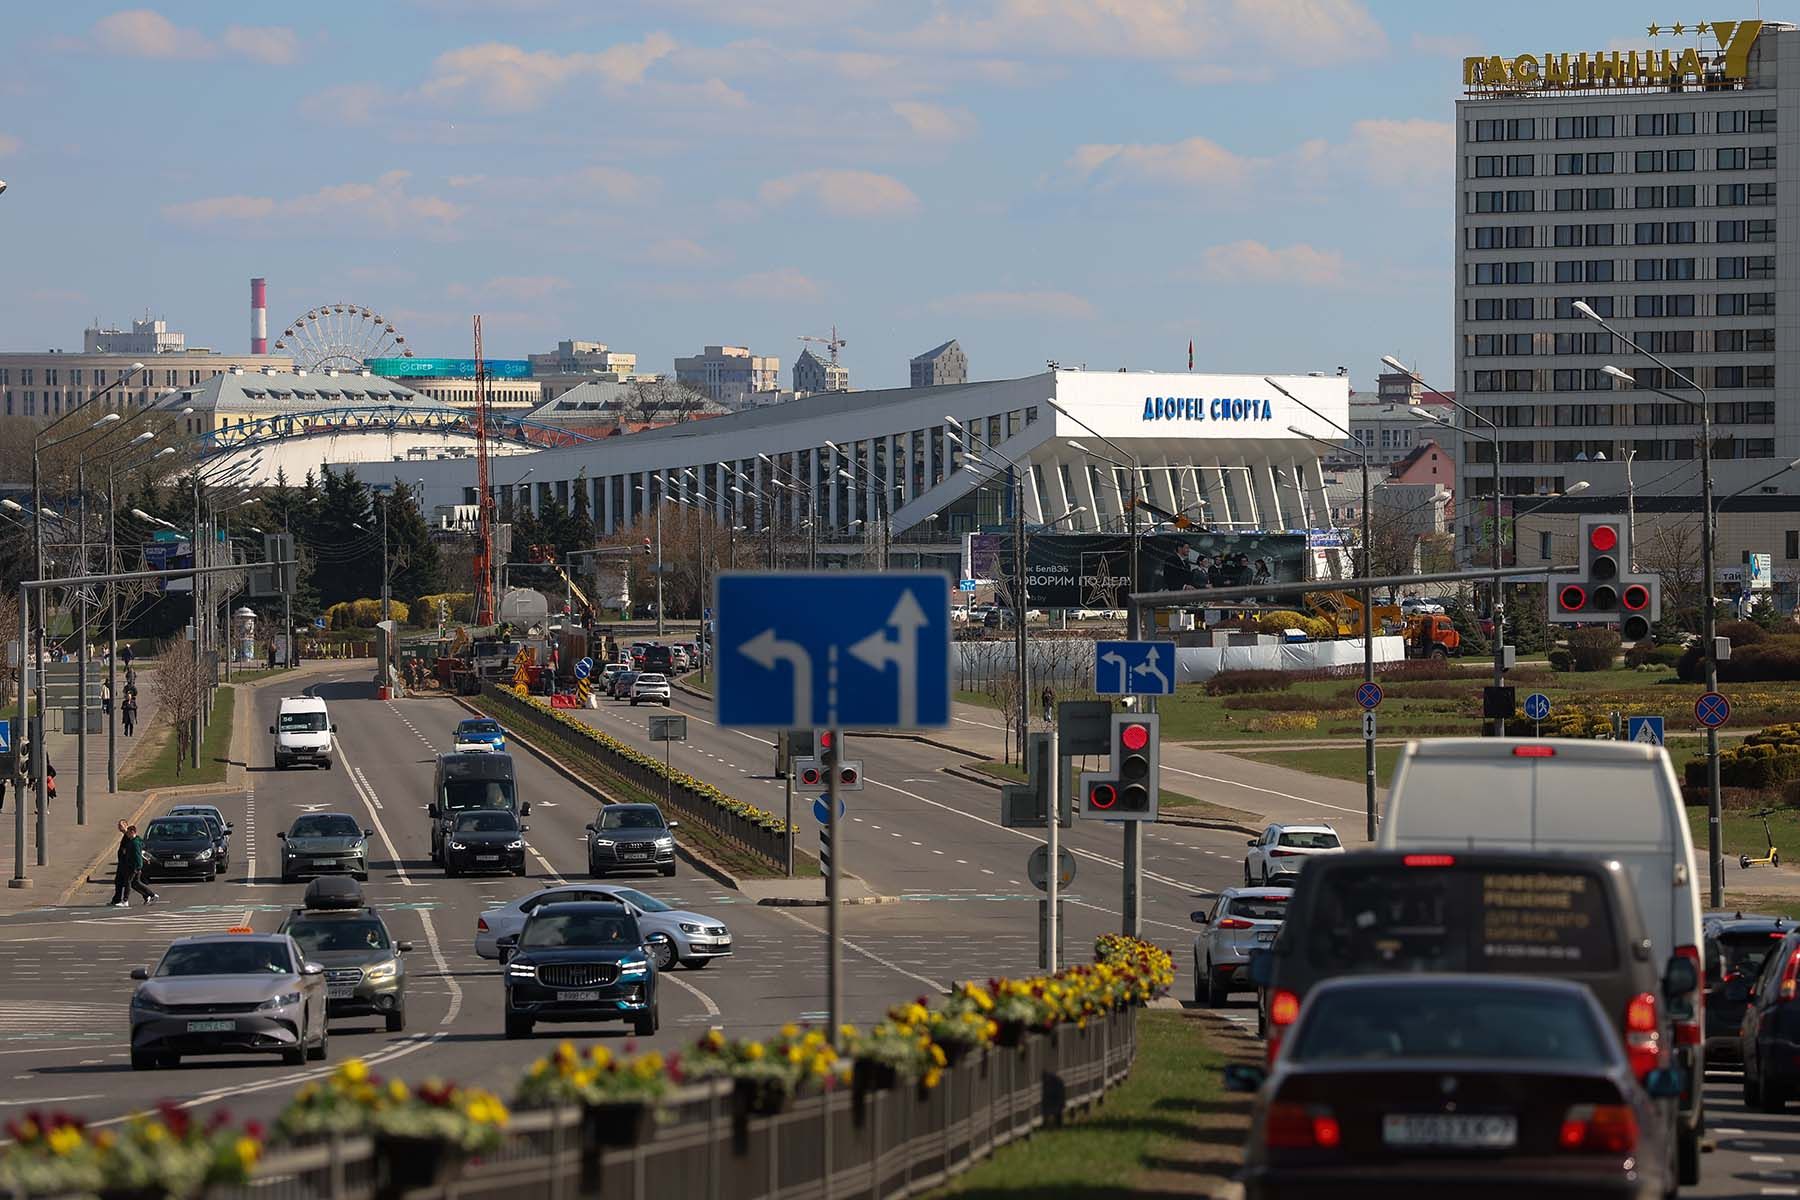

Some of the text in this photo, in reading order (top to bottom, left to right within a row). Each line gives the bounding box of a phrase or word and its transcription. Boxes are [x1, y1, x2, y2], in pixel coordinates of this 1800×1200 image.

[1464, 47, 1704, 86] ГАСЦІНІЦА
[1143, 397, 1272, 421] ДВОРЕЦ СПОРТА
